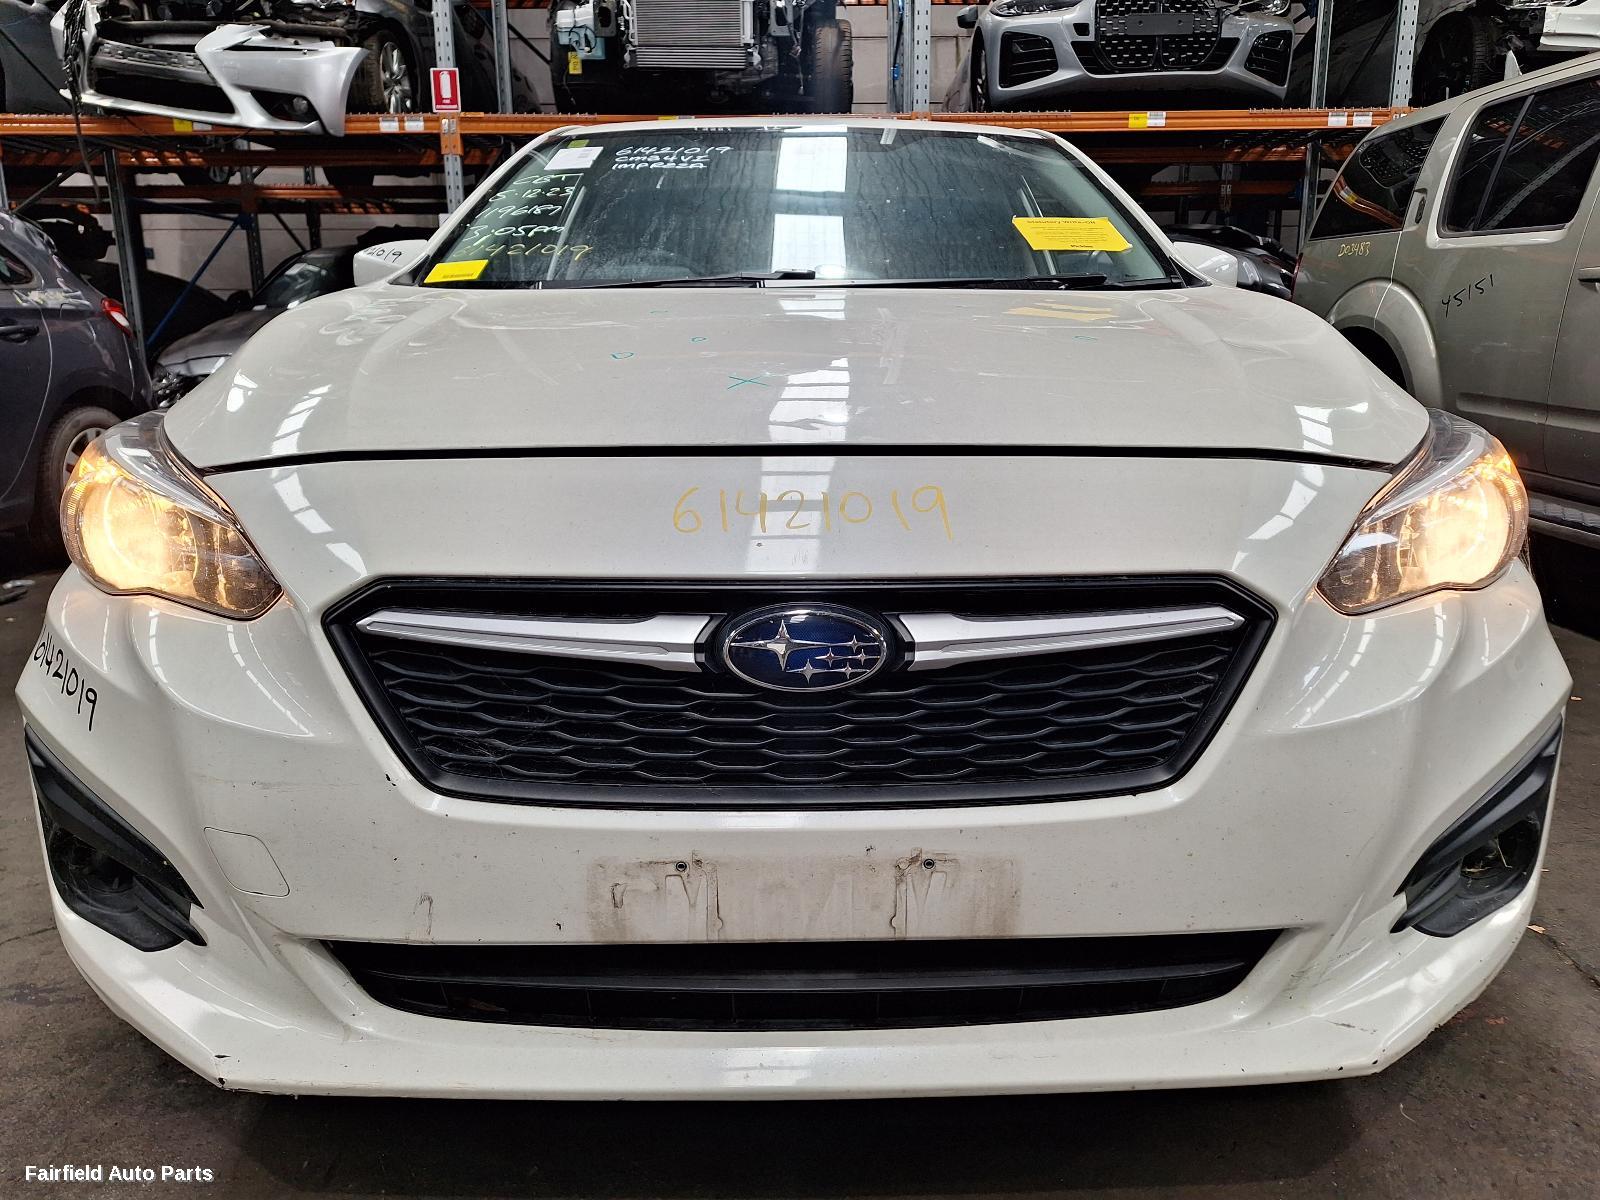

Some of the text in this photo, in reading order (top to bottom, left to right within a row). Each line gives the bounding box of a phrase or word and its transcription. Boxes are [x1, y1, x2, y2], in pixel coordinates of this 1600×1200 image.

[615, 146, 734, 156] 61421019
[1441, 273, 1495, 318] 45151
[672, 484, 954, 541] 61421019
[33, 623, 98, 732] 61421019
